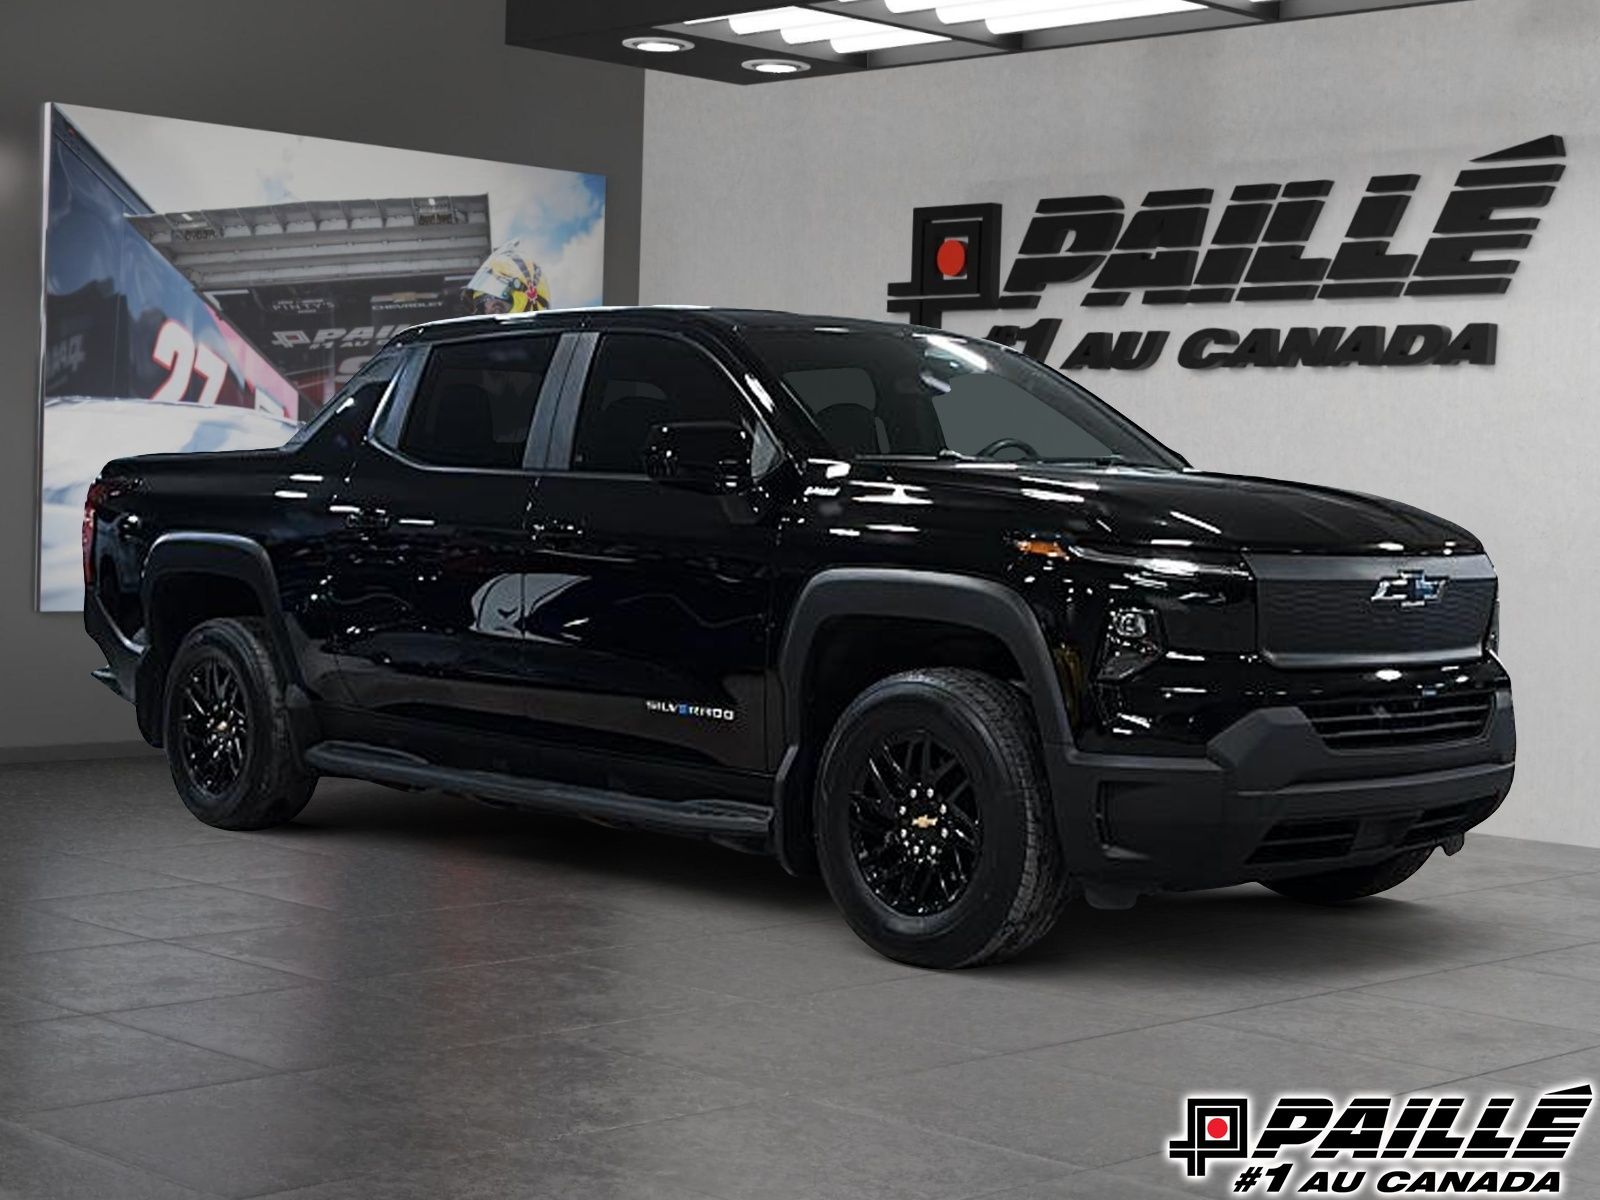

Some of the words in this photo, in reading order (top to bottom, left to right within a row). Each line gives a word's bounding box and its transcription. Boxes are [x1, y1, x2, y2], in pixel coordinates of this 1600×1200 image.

[1000, 134, 1566, 309] PAILLÉ
[372, 301, 443, 311] CHEVROLET
[149, 318, 229, 404] 27
[1060, 330, 1170, 371] AU
[1177, 322, 1498, 370] CANADA
[646, 700, 735, 721] SILVERADO
